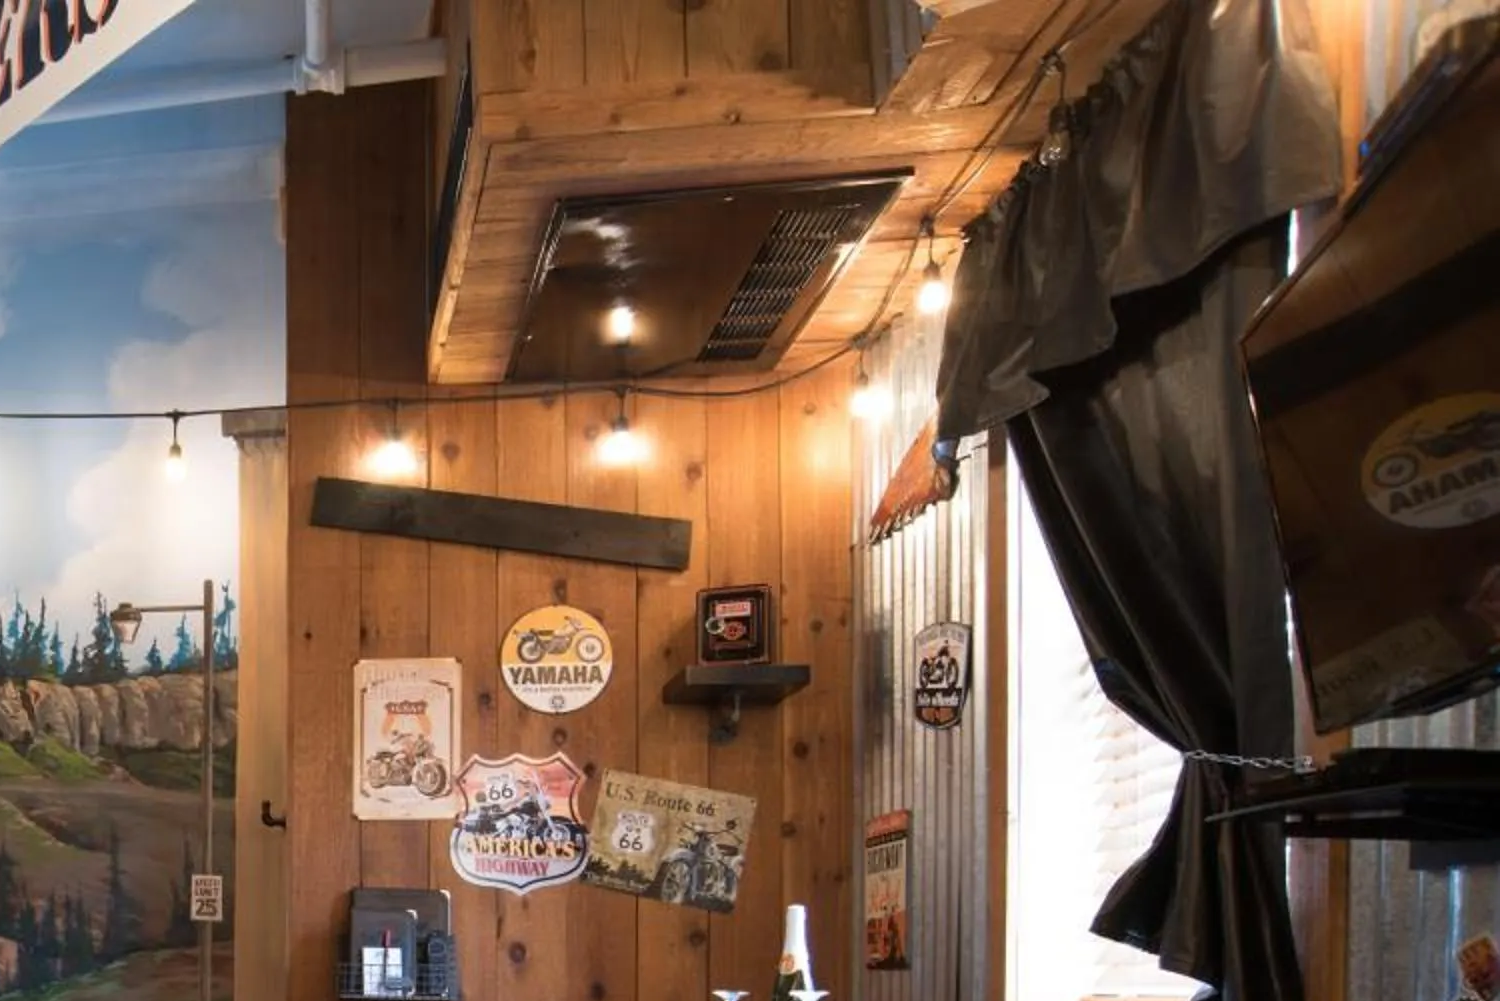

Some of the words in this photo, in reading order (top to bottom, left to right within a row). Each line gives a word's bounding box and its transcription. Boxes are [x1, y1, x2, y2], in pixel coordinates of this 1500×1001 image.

[508, 664, 604, 685] YAMAHA
[489, 783, 513, 801] 66
[643, 790, 693, 813] Route
[696, 801, 717, 817] 66
[619, 833, 643, 851] 66
[195, 898, 217, 916] 25
